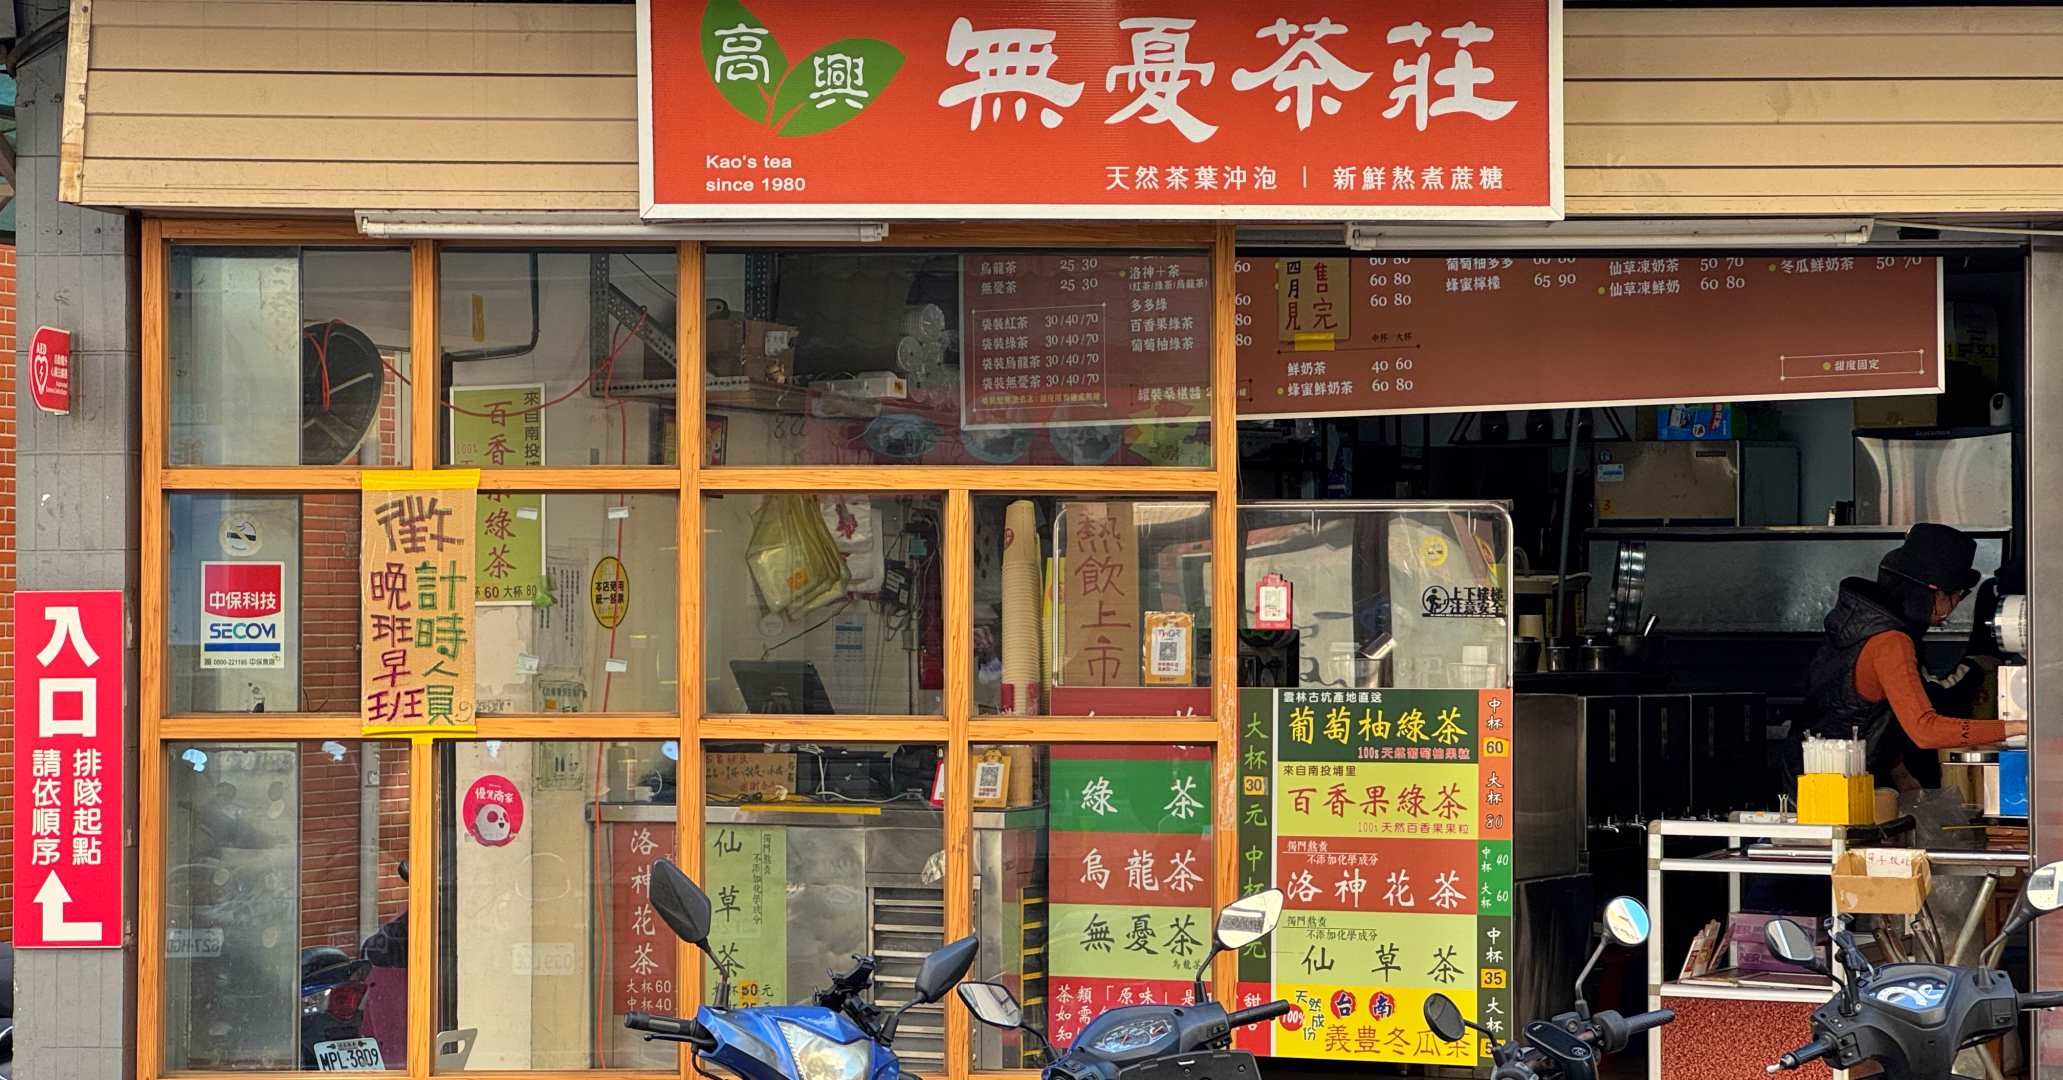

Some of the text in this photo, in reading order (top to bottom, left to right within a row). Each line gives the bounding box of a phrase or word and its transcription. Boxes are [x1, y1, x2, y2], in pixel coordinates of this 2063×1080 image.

[715, 22, 869, 111] 高興
[938, 16, 1519, 143] 無憂茶莊
[706, 154, 792, 170] Kao's tea
[706, 176, 806, 192] since 1980
[1106, 165, 1504, 191] 天然茶葉沖泡 新鮮熬煮蔗糖
[980, 258, 1098, 275] 烏龍茶 25 30
[1700, 258, 1718, 271] 50
[1726, 258, 1744, 270] 70
[1876, 257, 1895, 270] 50
[1060, 279, 1075, 292] 25
[1081, 278, 1098, 289] 30
[1370, 272, 1412, 287] 60 80
[1534, 273, 1551, 288] 65
[1558, 273, 1576, 287] 90
[1700, 277, 1719, 290] 60
[1726, 275, 1745, 289] 80
[1286, 260, 1301, 331] 四月見
[1313, 262, 1339, 330] 售完
[1370, 293, 1412, 307] 60 80
[1287, 357, 1413, 376] 鮮奶茶 40 60
[1372, 379, 1389, 392] 60
[1395, 377, 1413, 391] 80
[524, 391, 541, 465] 來自南投
[208, 590, 277, 611] 中保科技
[484, 586, 499, 599] 60
[504, 586, 523, 598] 大杯
[1074, 513, 1131, 687] 熱飲上市
[209, 622, 276, 639] SECOM
[415, 560, 468, 724] 計時人員
[367, 563, 425, 722] 晚班早班
[36, 606, 100, 738] 入口
[1284, 691, 1383, 704] 雲林古坑產地直送
[1289, 705, 1468, 745] 葡萄柚綠茶
[1487, 741, 1503, 753] 60
[1284, 765, 1356, 777] 來自南投埔里
[32, 749, 61, 866] 請依順序
[73, 748, 102, 866] 排隊起點
[1081, 776, 1204, 819] 綠茶
[1288, 782, 1468, 820] 百香果綠茶
[1080, 848, 1203, 893] 烏龍茶
[1496, 854, 1509, 866] 40
[1287, 868, 1468, 909] 洛神花茶
[1496, 891, 1509, 902] 60
[630, 831, 659, 974] 洛神花茶
[713, 829, 744, 977] 仙草茶
[1080, 913, 1203, 957] 無憂茶
[1301, 943, 1464, 984] 仙草茶
[742, 984, 758, 995] 50
[1484, 972, 1503, 984] 35
[1335, 993, 1393, 1018] 台南
